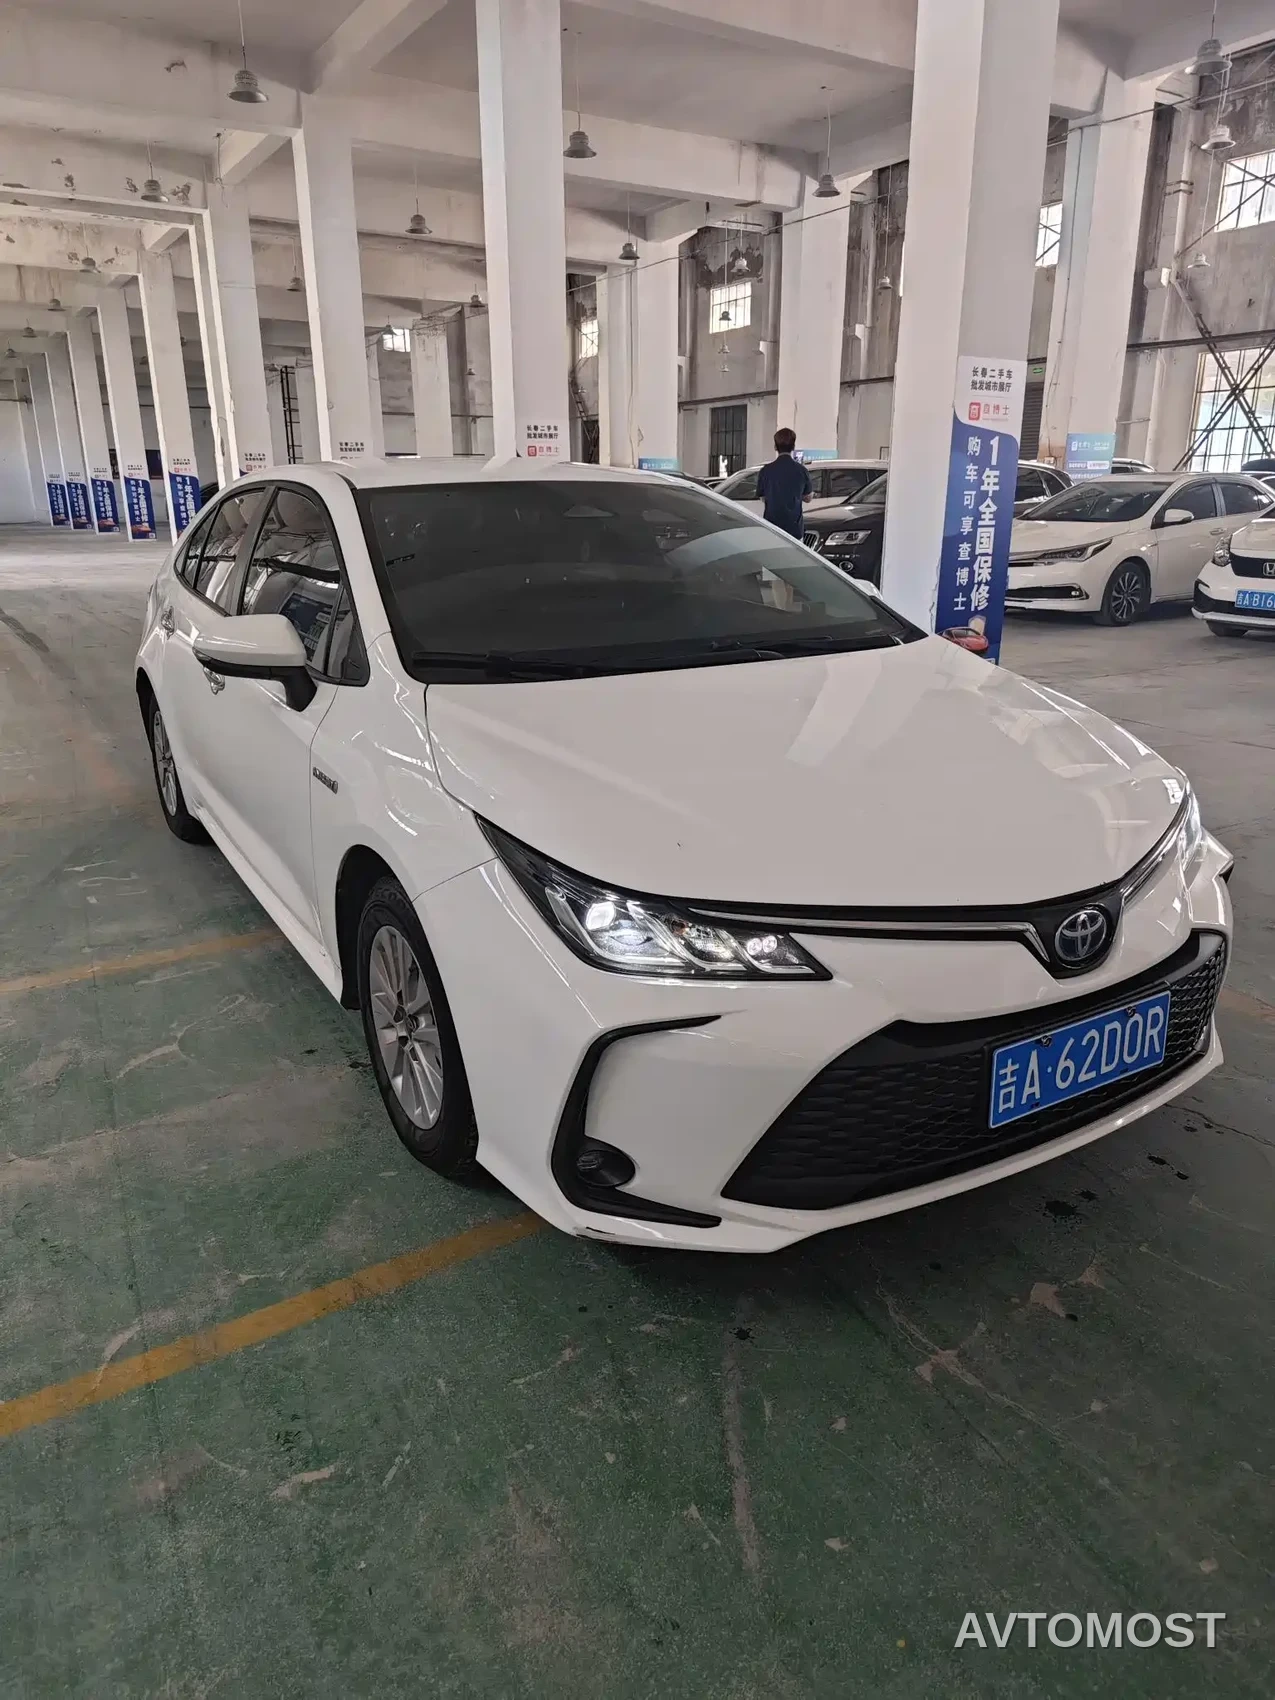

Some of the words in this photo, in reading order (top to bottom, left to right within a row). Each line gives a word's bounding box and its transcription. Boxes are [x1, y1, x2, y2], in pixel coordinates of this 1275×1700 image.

[970, 379, 1013, 393] 批发城市展厅
[972, 366, 1013, 380] 长春二手车
[953, 436, 982, 611] 购车可享查博士
[969, 435, 1001, 612] 1年全国保修
